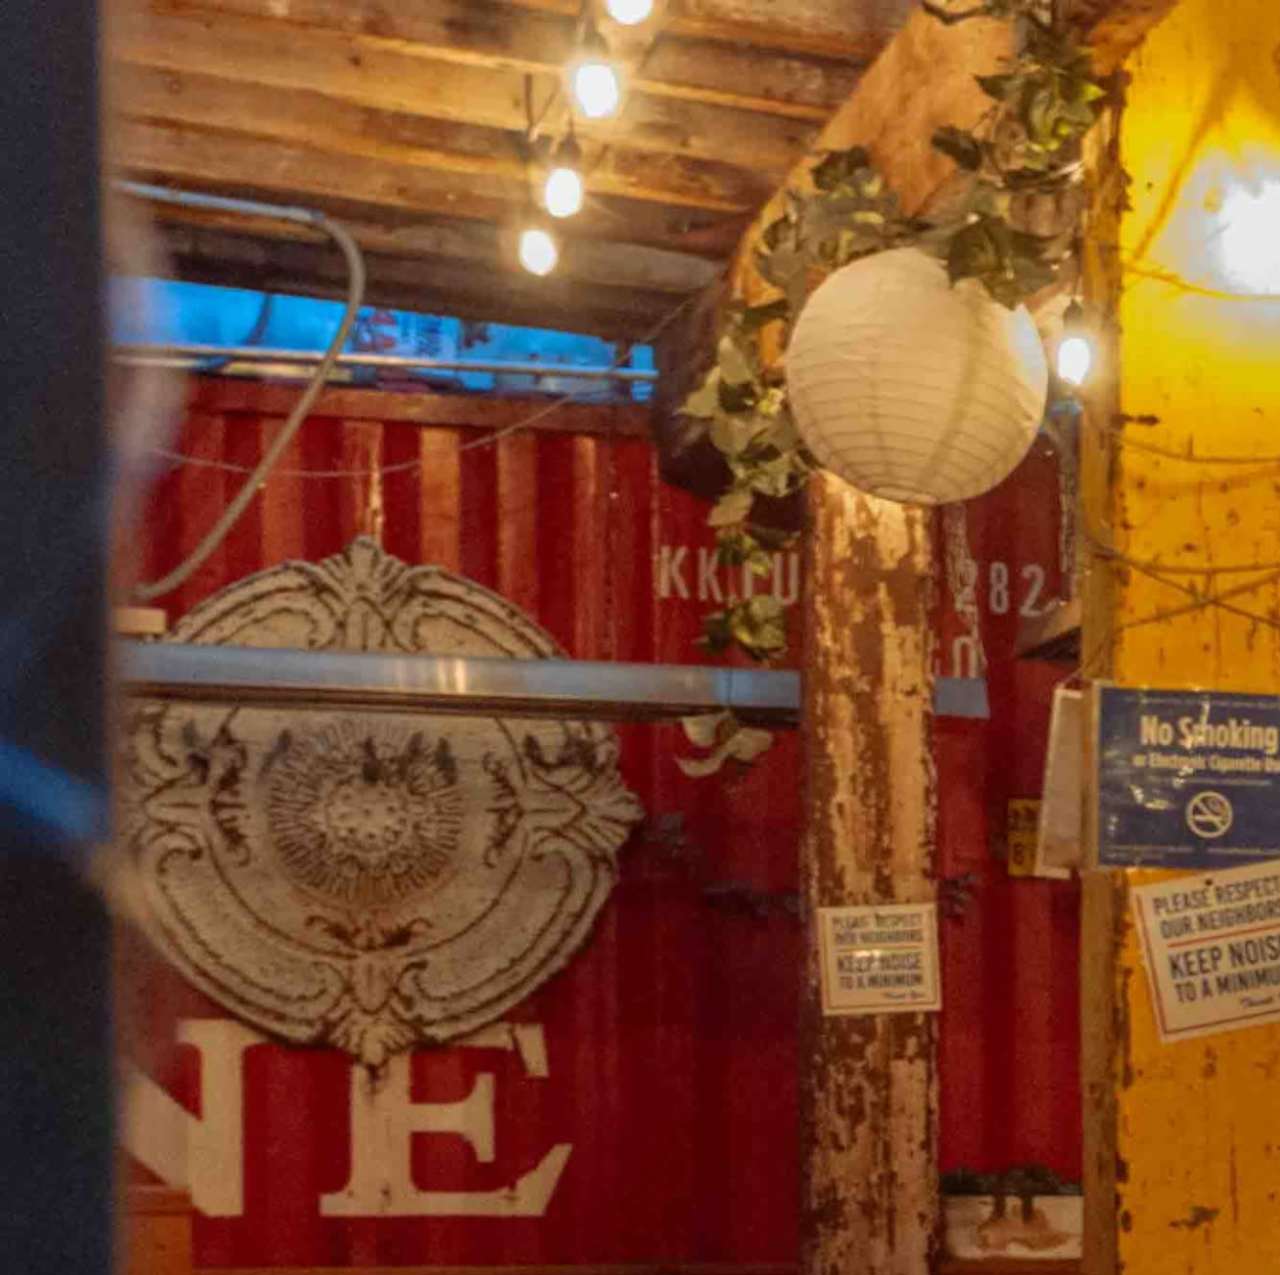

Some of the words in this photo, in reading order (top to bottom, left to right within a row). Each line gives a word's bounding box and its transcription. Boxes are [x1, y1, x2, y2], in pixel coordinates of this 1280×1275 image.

[1140, 714, 1173, 746] No
[1178, 716, 1280, 755] Smoking
[1152, 888, 1210, 915] PLEASE
[1160, 914, 1196, 939] OUR
[1168, 945, 1223, 980] KEEP
[1175, 981, 1197, 1004] TO
[1202, 978, 1214, 998] A
